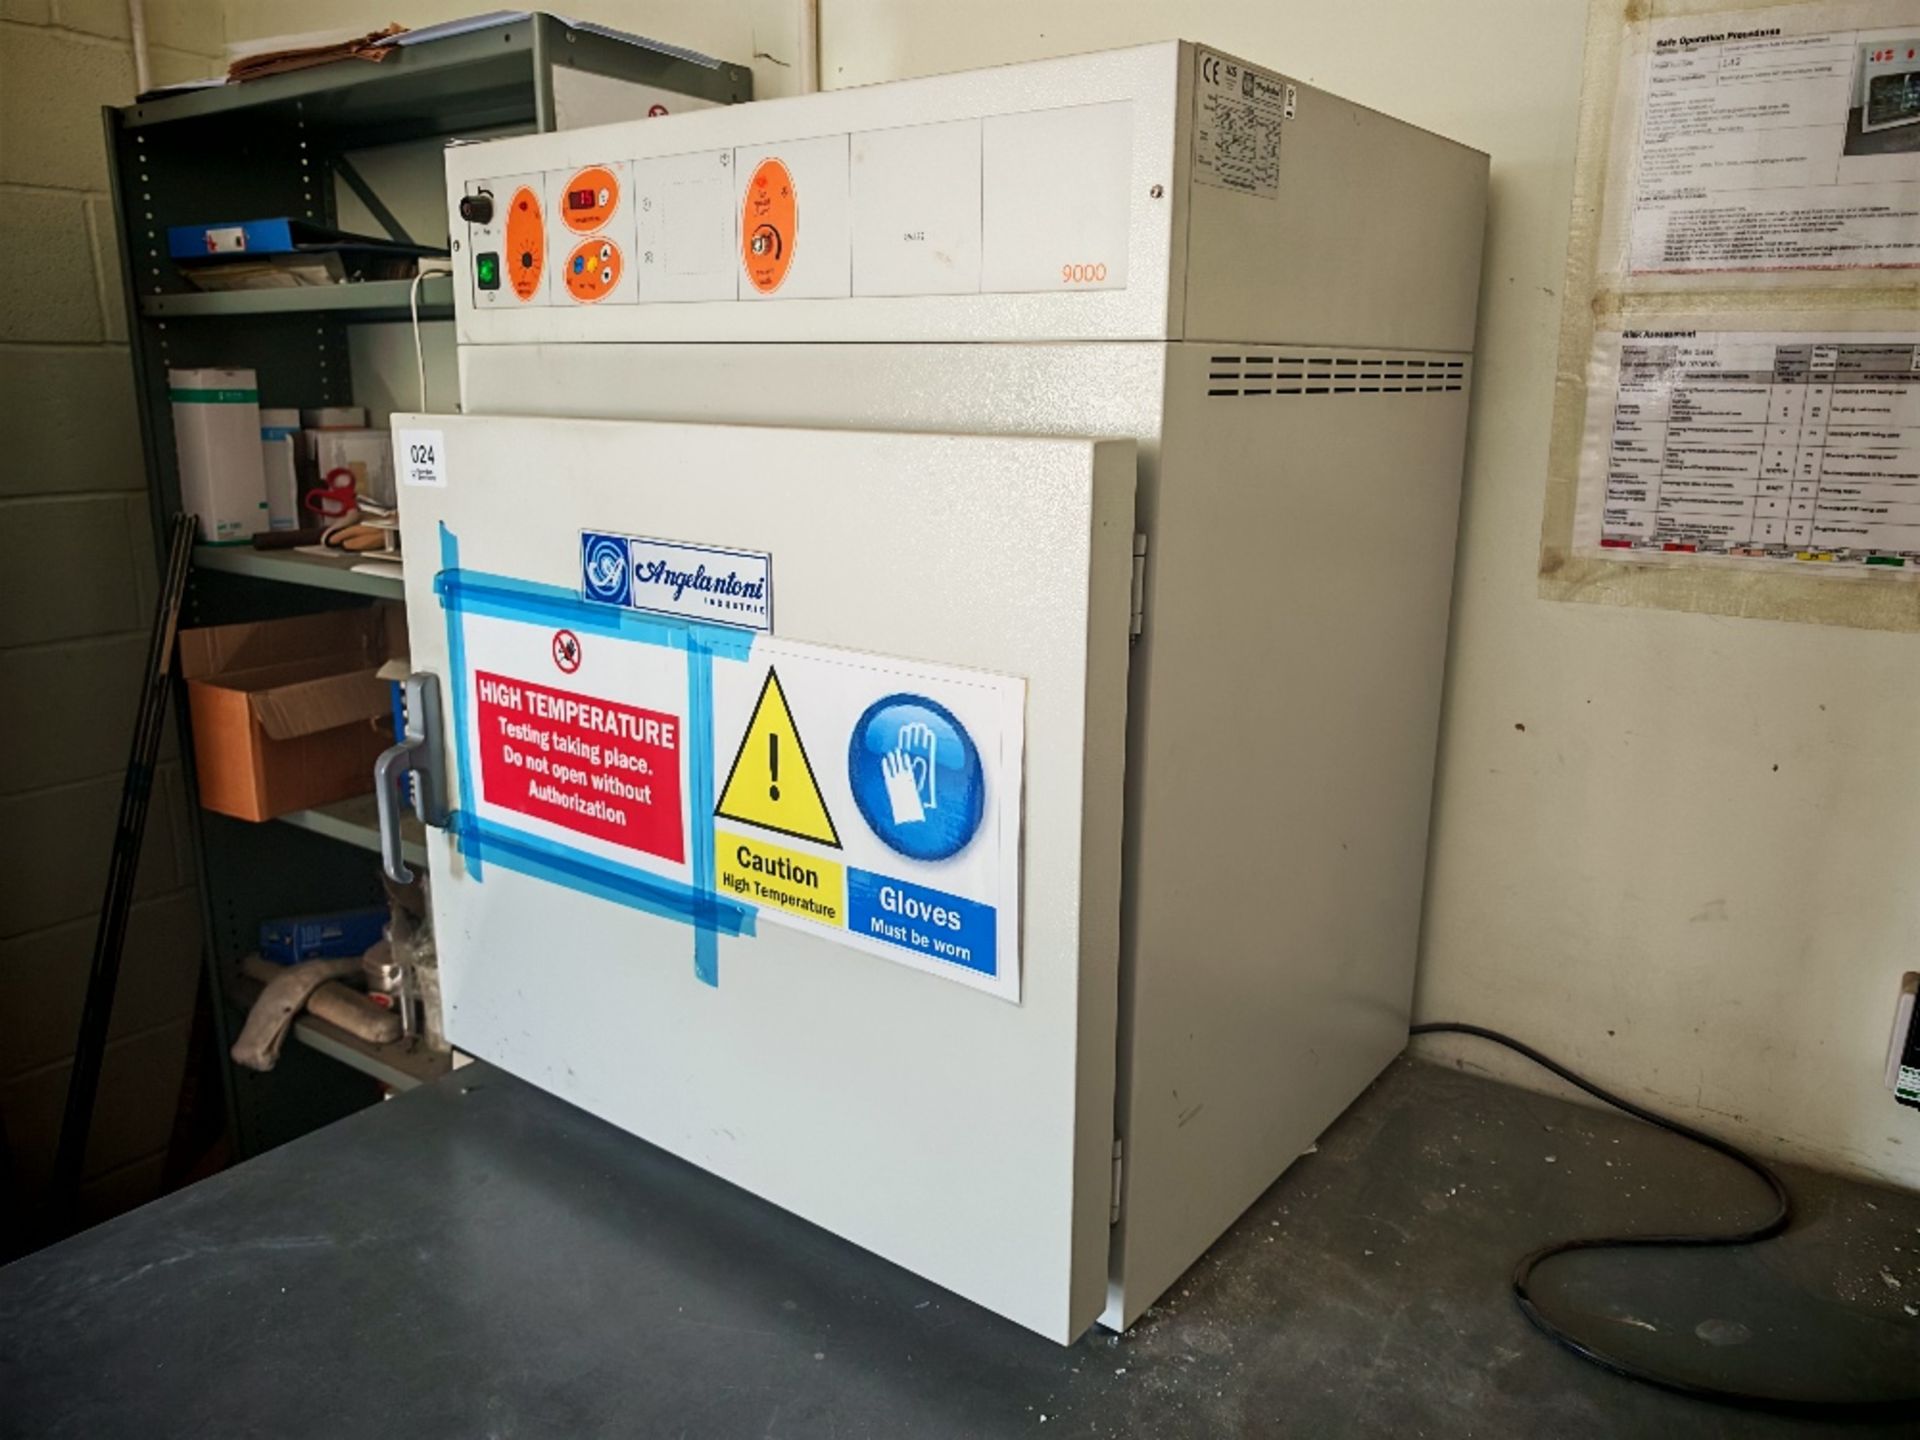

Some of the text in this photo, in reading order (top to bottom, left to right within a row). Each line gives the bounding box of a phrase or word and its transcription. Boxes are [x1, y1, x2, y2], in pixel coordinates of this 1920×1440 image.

[1679, 33, 1725, 46] Operation
[1062, 263, 1107, 283] 9000
[1643, 330, 1697, 339] Assessment
[410, 444, 435, 465] 024
[635, 560, 765, 602] Angelantoni
[479, 679, 675, 750] HIGH TEMPERATURE
[498, 716, 653, 776] Testing taking place.
[503, 746, 652, 805] Do not open without
[528, 779, 627, 826] Authorization
[736, 845, 819, 889] Caution
[723, 872, 836, 920] High Temperature
[879, 886, 962, 931] Gloves
[871, 917, 971, 962] Must be worn
